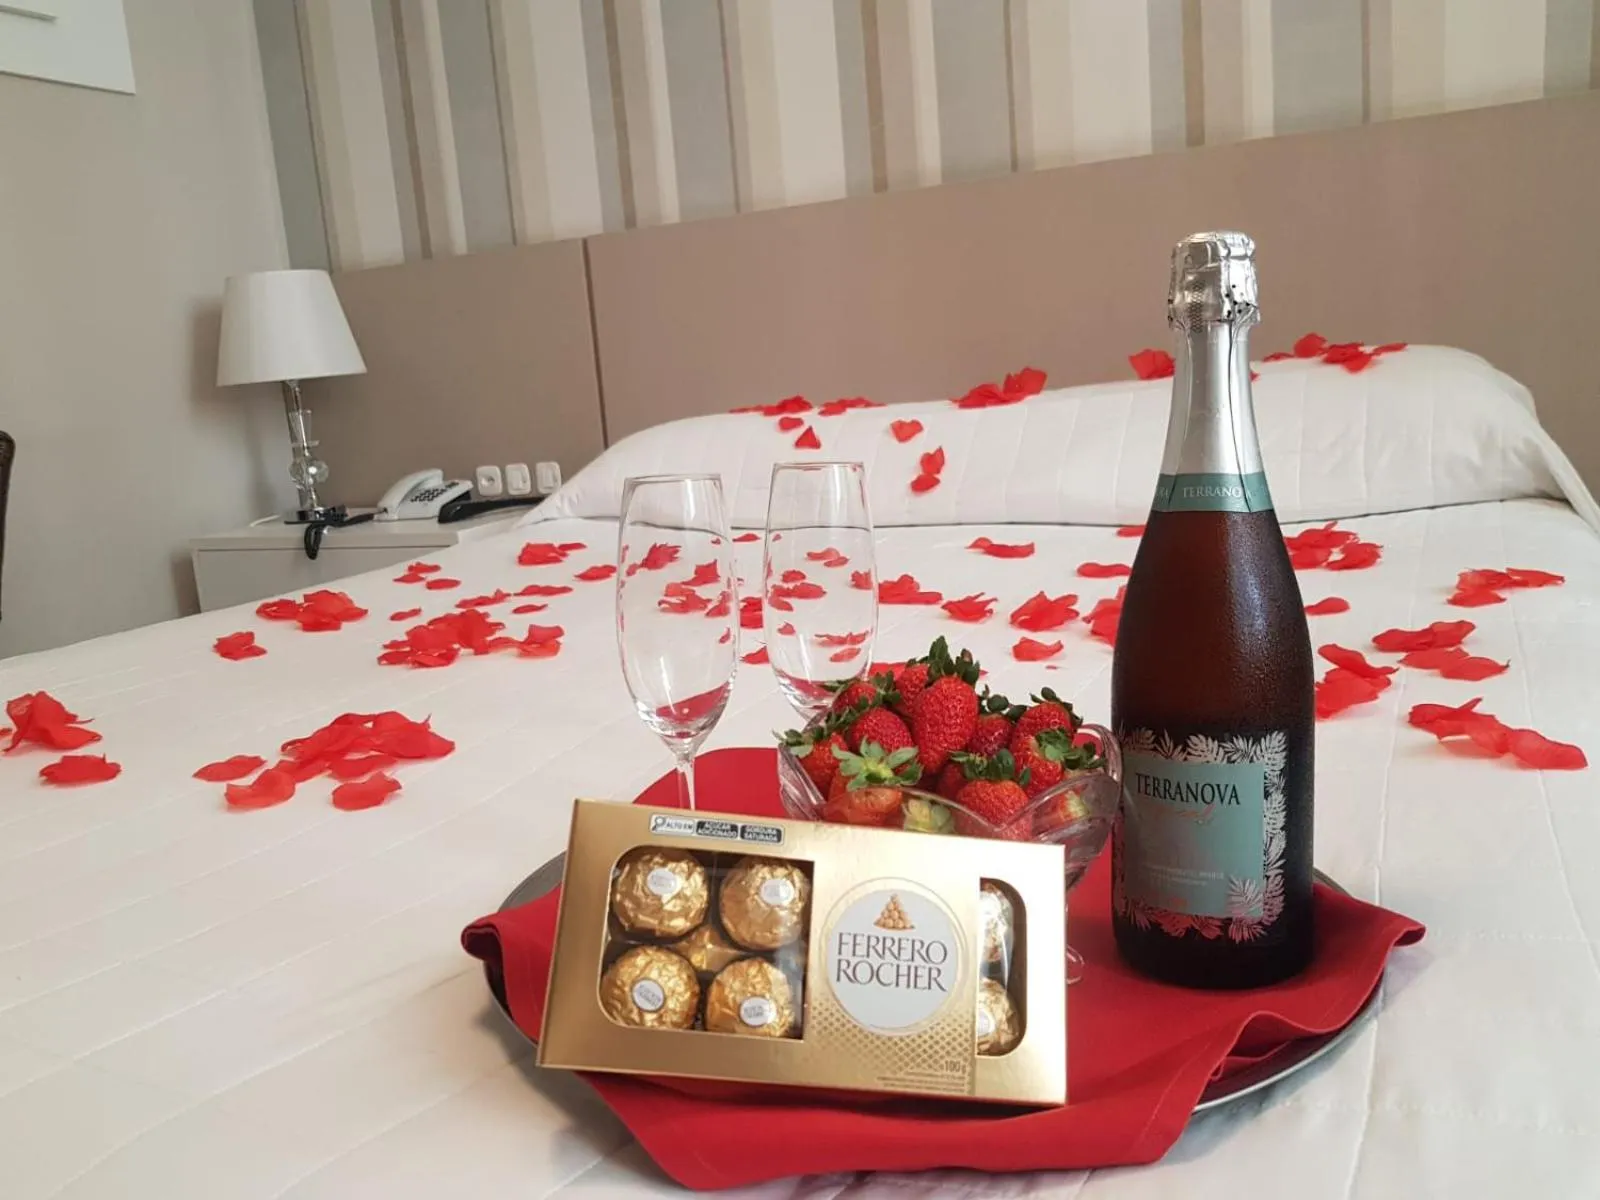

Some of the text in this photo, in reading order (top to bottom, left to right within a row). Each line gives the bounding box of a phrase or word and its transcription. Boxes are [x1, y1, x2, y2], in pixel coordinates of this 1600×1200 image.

[1183, 485, 1248, 499] TERRANO
[1135, 772, 1241, 806] TERRANOVA
[837, 932, 948, 966] FERRERO
[836, 958, 947, 992] ROCHER
